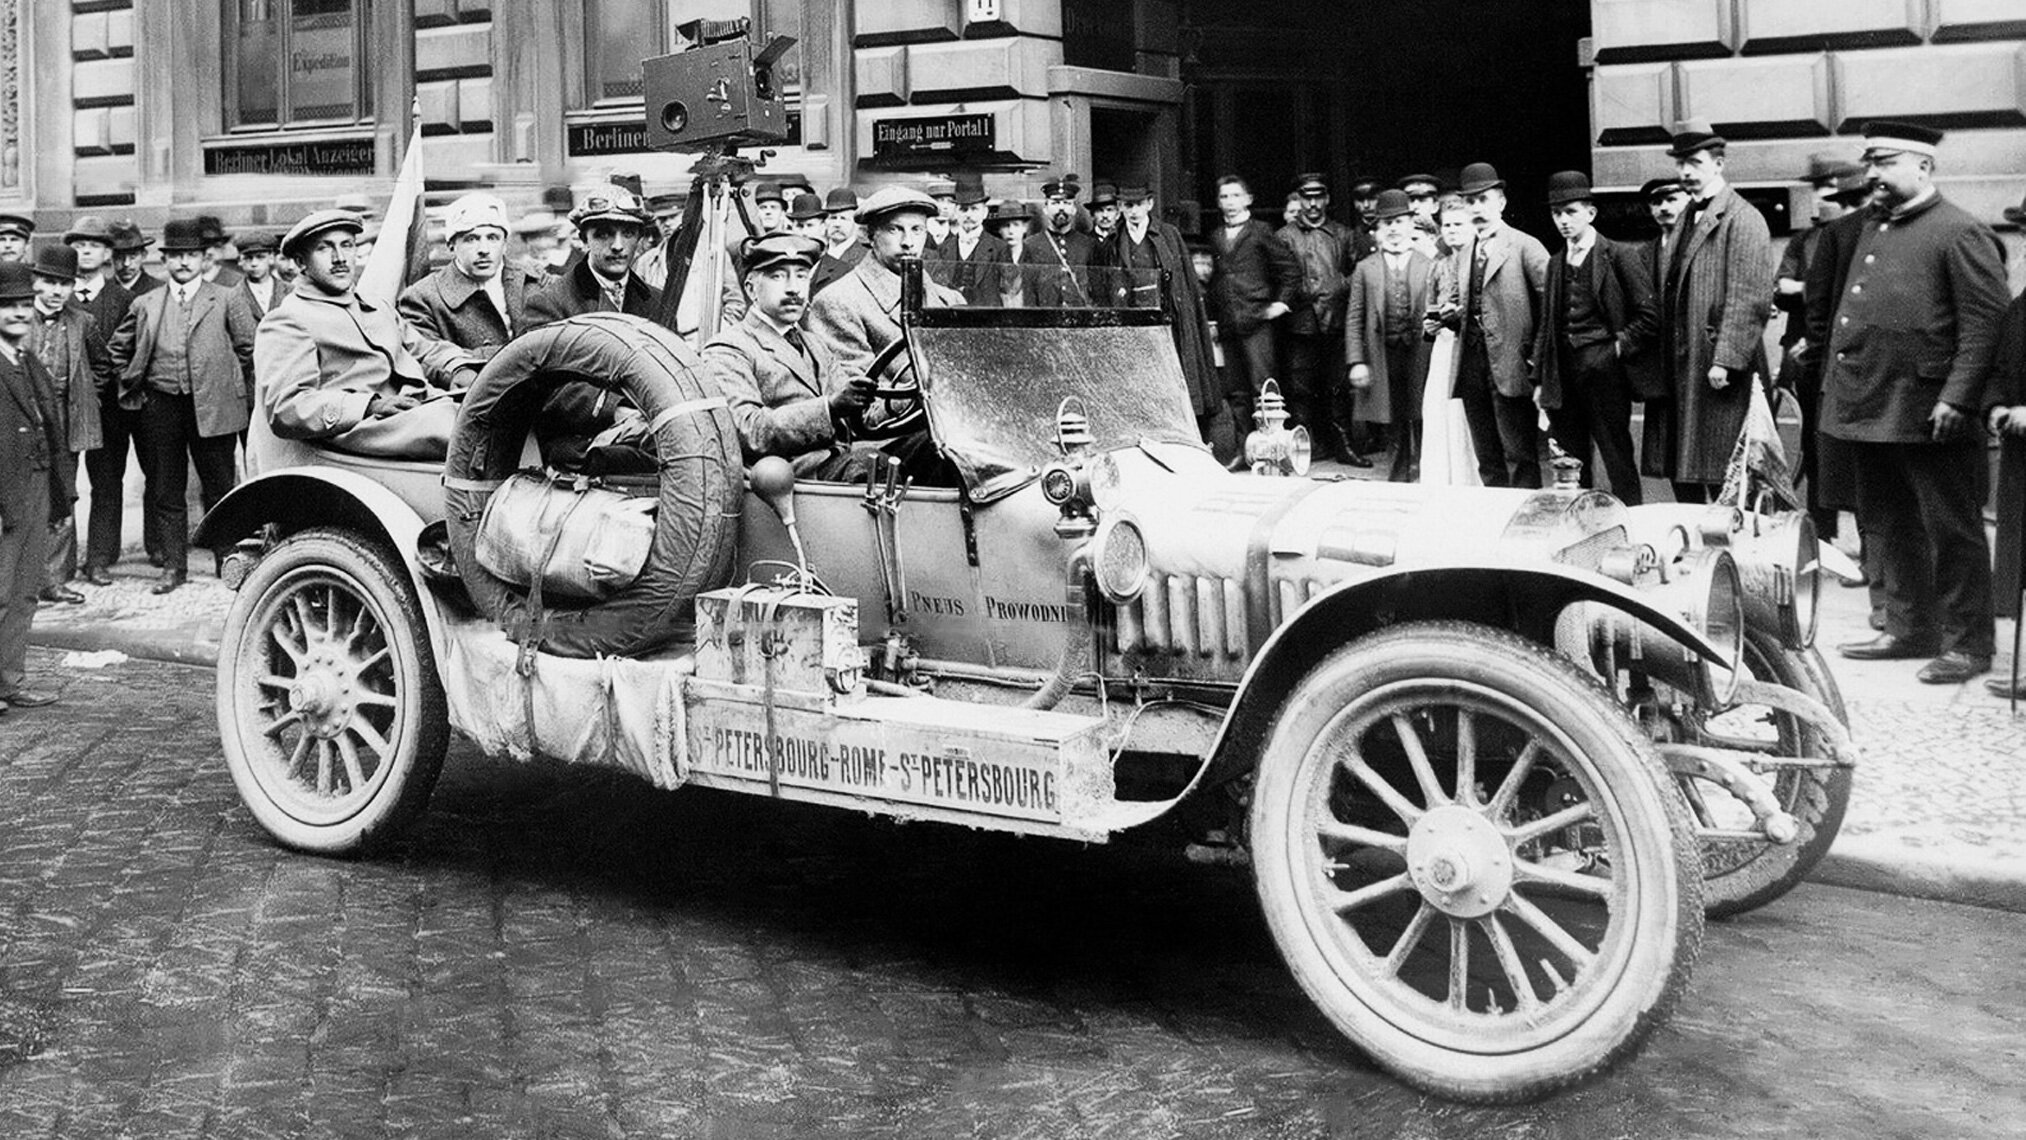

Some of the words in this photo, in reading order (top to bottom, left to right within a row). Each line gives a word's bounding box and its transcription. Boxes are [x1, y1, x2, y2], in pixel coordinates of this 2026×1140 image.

[878, 124, 923, 144] Eingang
[926, 124, 946, 139] nur
[947, 119, 982, 138] Portal
[921, 754, 1056, 810] PETERSBOURG
